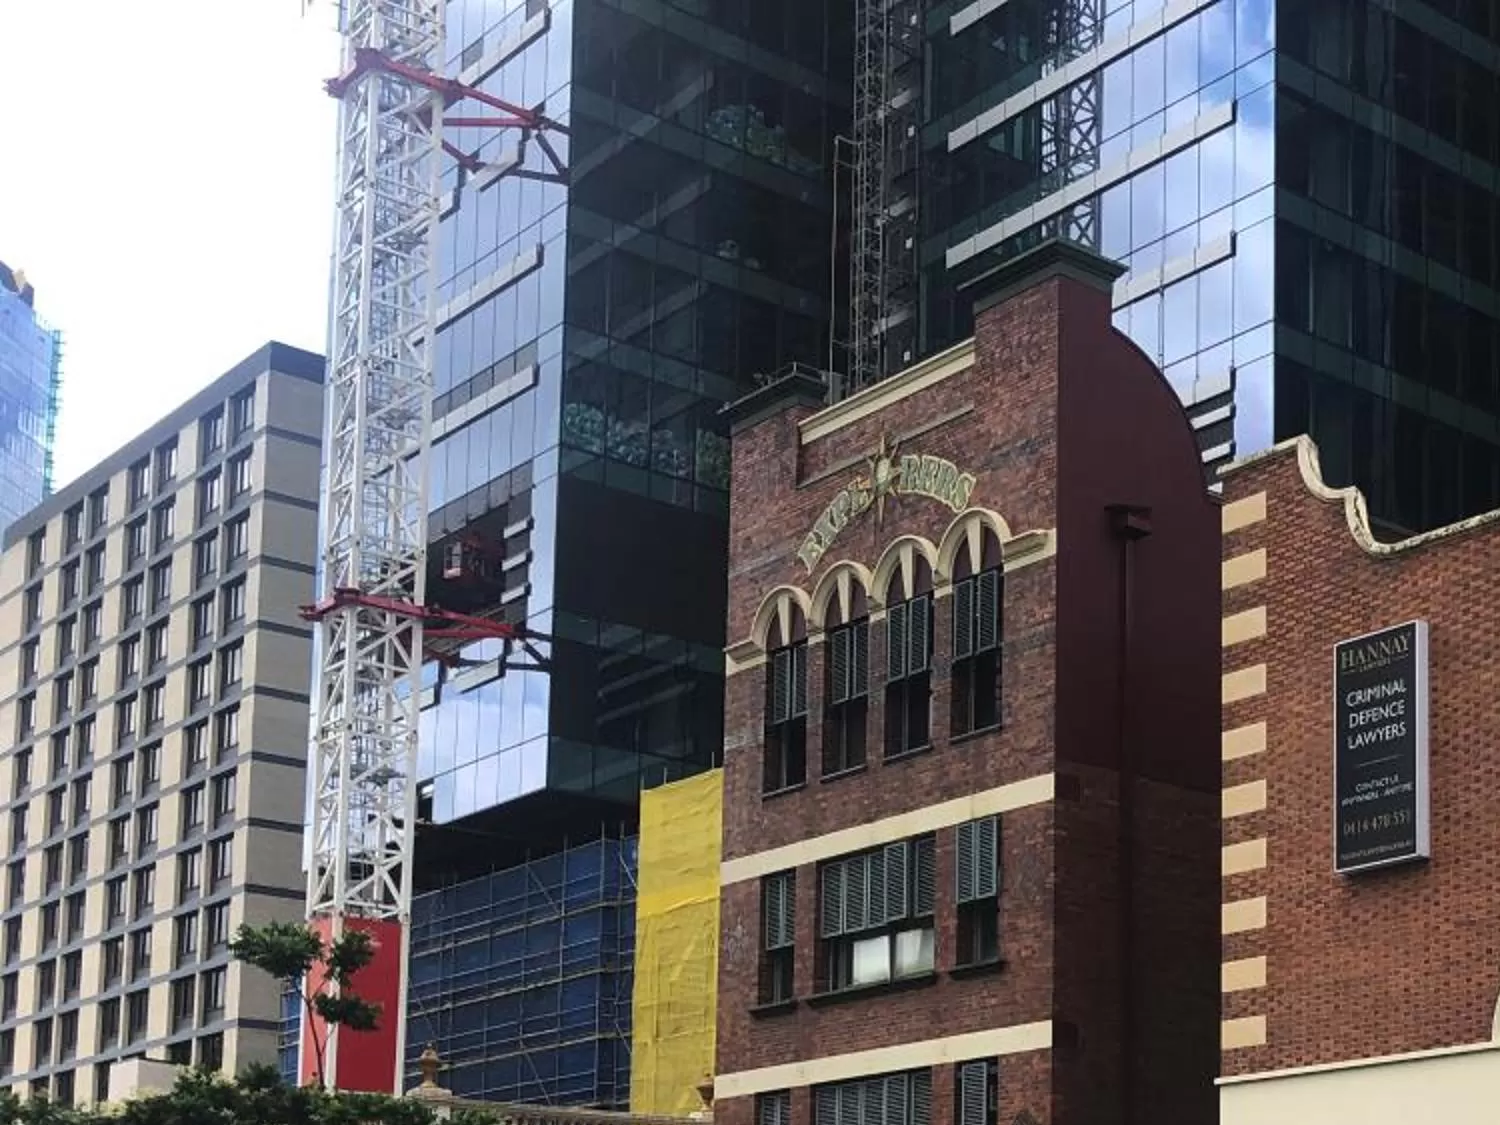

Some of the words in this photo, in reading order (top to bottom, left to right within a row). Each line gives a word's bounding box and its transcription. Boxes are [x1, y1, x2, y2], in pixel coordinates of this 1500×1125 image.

[1341, 632, 1412, 669] HANNAY
[1345, 678, 1408, 707] CRIMINAL
[1349, 699, 1405, 729] DEFENCE
[1347, 721, 1407, 749] LAWYERS
